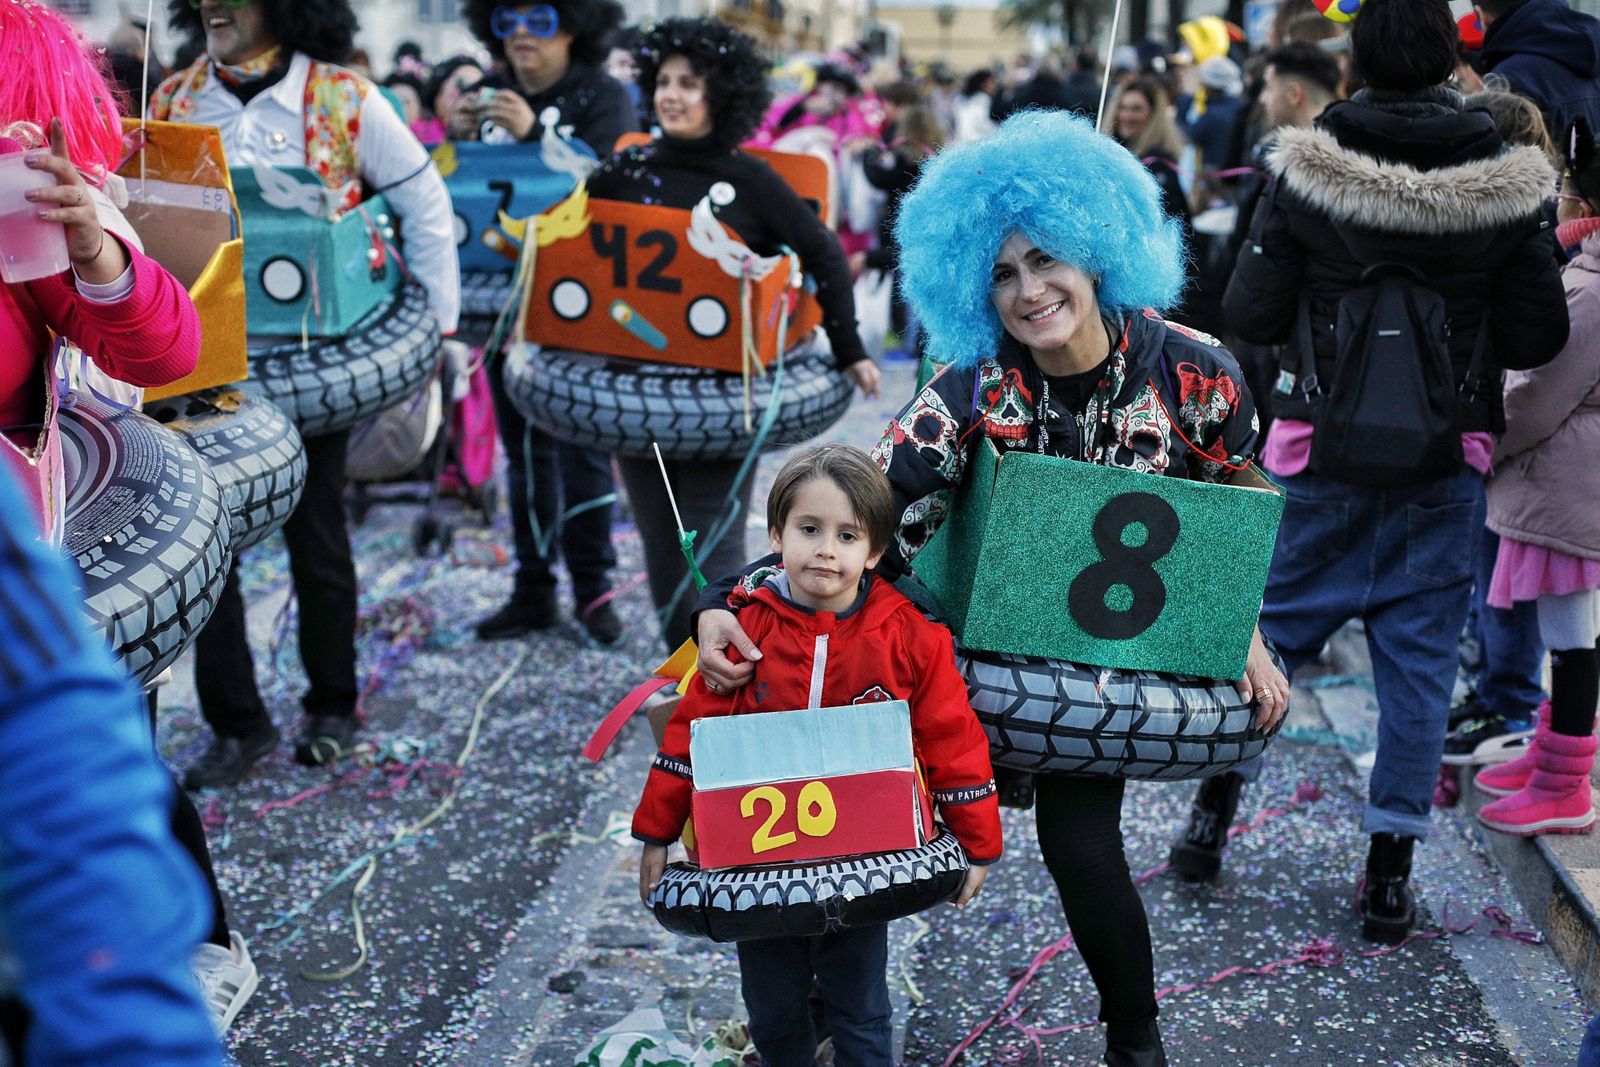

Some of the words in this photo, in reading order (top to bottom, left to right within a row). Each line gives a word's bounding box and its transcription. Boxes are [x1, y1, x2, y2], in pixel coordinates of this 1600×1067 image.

[488, 181, 514, 225] 7
[590, 224, 682, 293] 42
[1042, 380, 1050, 402] LEAGUE
[1068, 491, 1181, 640] 8
[663, 759, 693, 776] PATROL
[936, 792, 954, 802] PAW
[958, 787, 988, 801] PATROL
[740, 780, 837, 854] 20
